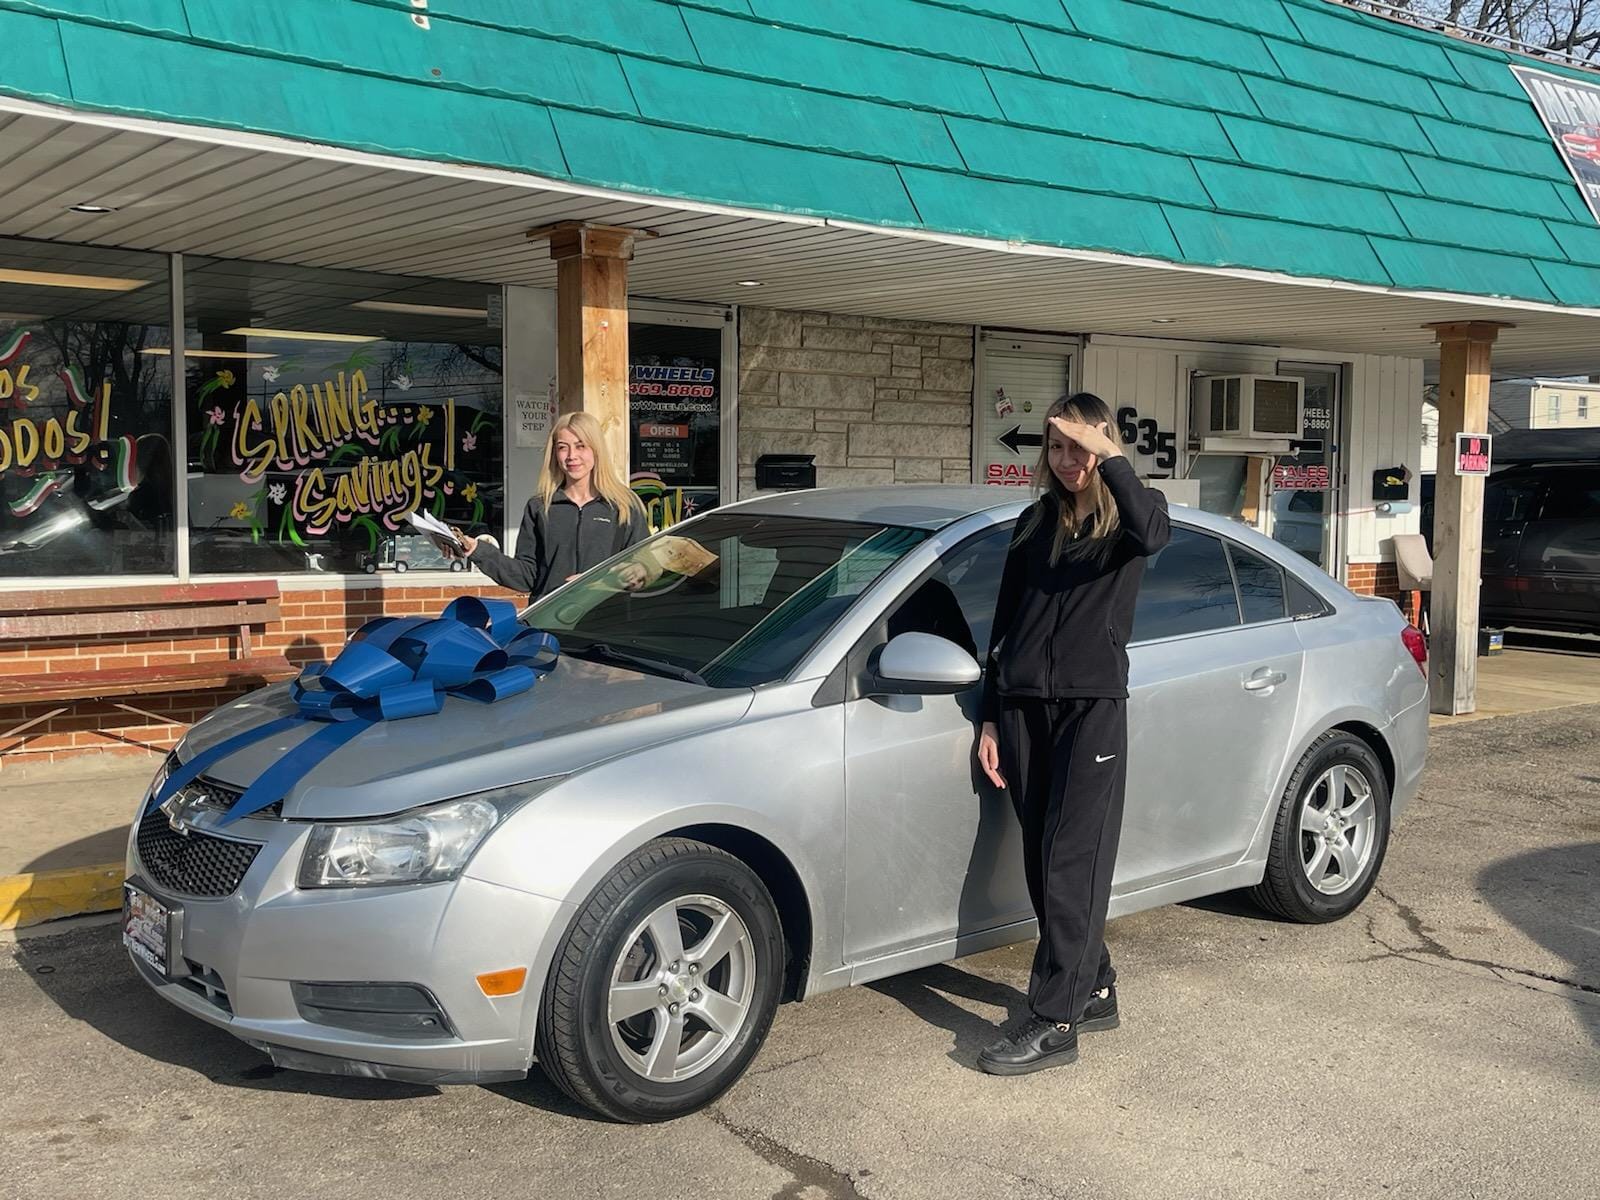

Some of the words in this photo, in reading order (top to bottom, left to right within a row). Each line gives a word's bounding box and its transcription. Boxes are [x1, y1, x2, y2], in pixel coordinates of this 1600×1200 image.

[636, 365, 715, 382] WHEELS
[517, 400, 549, 411] WATCH
[522, 412, 547, 420] YOUR
[522, 422, 545, 431] STEP
[650, 426, 680, 436] OPEN
[1117, 407, 1176, 469] 635
[1470, 439, 1480, 454] NO
[988, 464, 1034, 479] SAL
[1274, 465, 1328, 479] SALES
